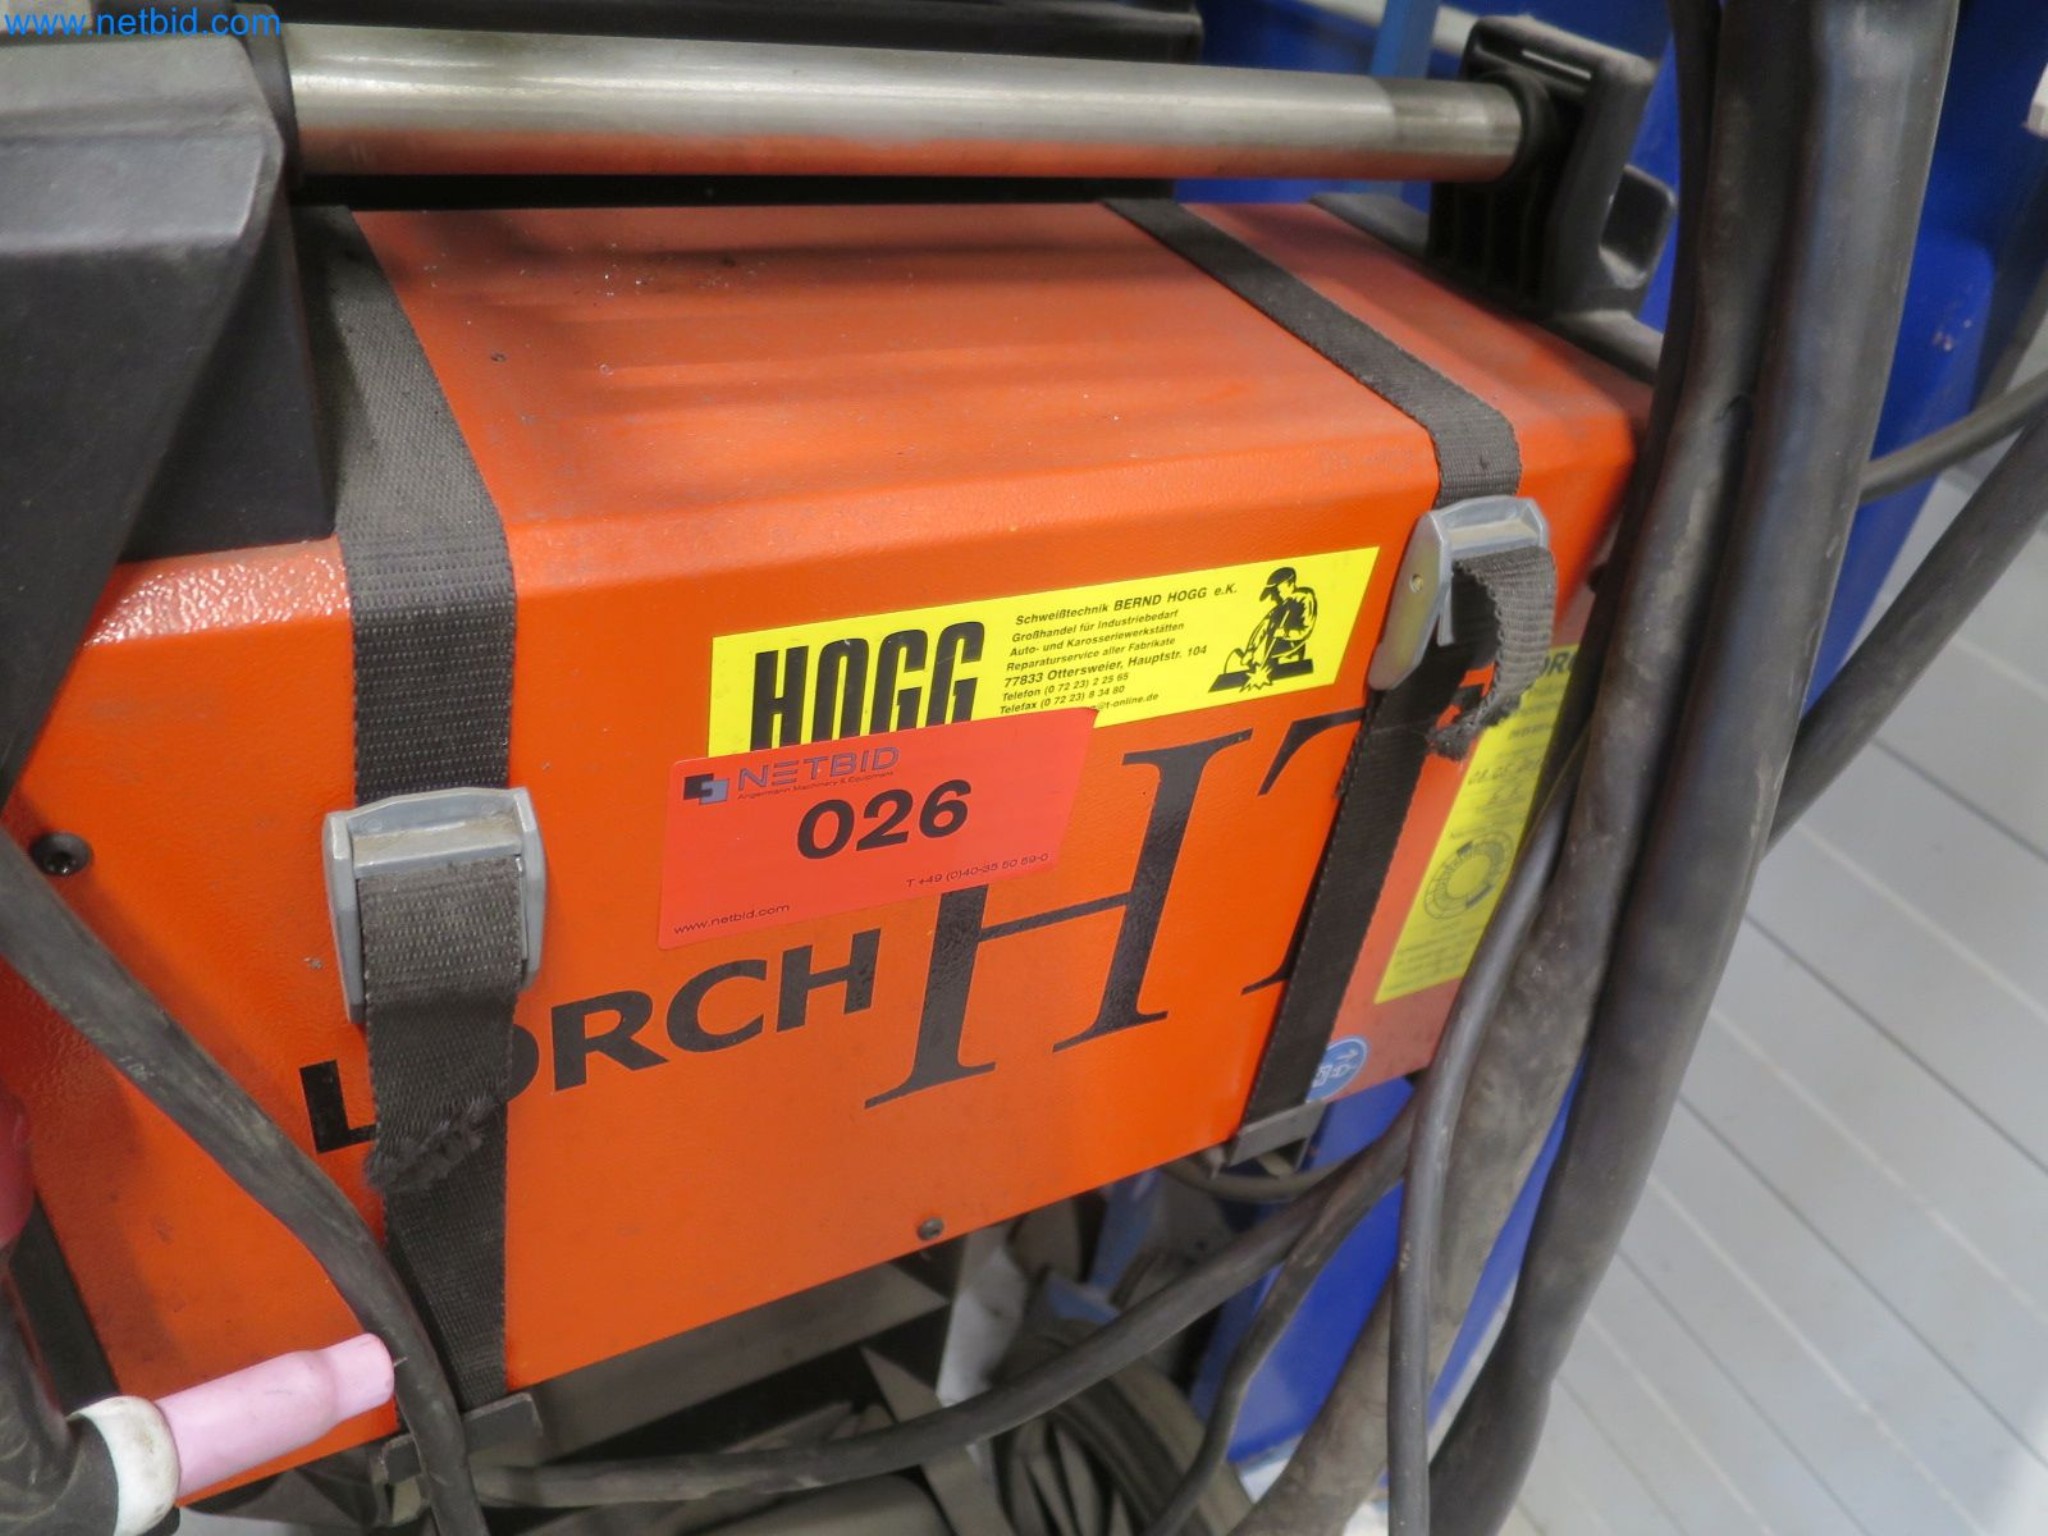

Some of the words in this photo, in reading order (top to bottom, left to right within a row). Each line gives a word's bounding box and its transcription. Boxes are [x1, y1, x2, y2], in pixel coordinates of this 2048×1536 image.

[1016, 603, 1108, 626] Schweißtechnik
[1114, 594, 1162, 611] BERND
[1167, 587, 1207, 603] HOGG
[1213, 583, 1237, 596] e.K.
[1009, 645, 1040, 657] Auto-
[1043, 639, 1064, 651] und
[1066, 622, 1185, 647] Karosseriewerkstätten
[1011, 624, 1077, 643] Großhandel
[1079, 621, 1095, 634] für
[1097, 609, 1179, 629] Industriebedarf
[1004, 672, 1043, 688] 77833
[1047, 660, 1124, 681] Ottersweier,
[1128, 650, 1183, 667] Hauptstr.
[1187, 645, 1208, 657] 104
[1006, 650, 1099, 672] Reparaturservice
[1102, 645, 1125, 657] aller
[1128, 637, 1176, 652] Fabrikate
[750, 621, 985, 751] HOGG
[1000, 700, 1037, 714] Telefax
[1040, 698, 1051, 710] (0
[1054, 695, 1067, 706] 72
[1069, 691, 1085, 704] 23)
[1098, 688, 1110, 698] 34
[1002, 688, 1041, 702] Telefon
[1044, 685, 1055, 697] (0
[1058, 682, 1071, 692] 72
[1073, 679, 1089, 692] 23)
[1091, 692, 1159, 710] @t-online.de
[738, 746, 899, 791] NETBID
[797, 779, 971, 860] 026
[906, 879, 915, 887] T
[919, 873, 942, 885] +49
[946, 863, 998, 882] (0)40-35
[1002, 859, 1017, 869] 50
[673, 904, 790, 934] www.netbid.com
[299, 928, 881, 1154] LRCH
